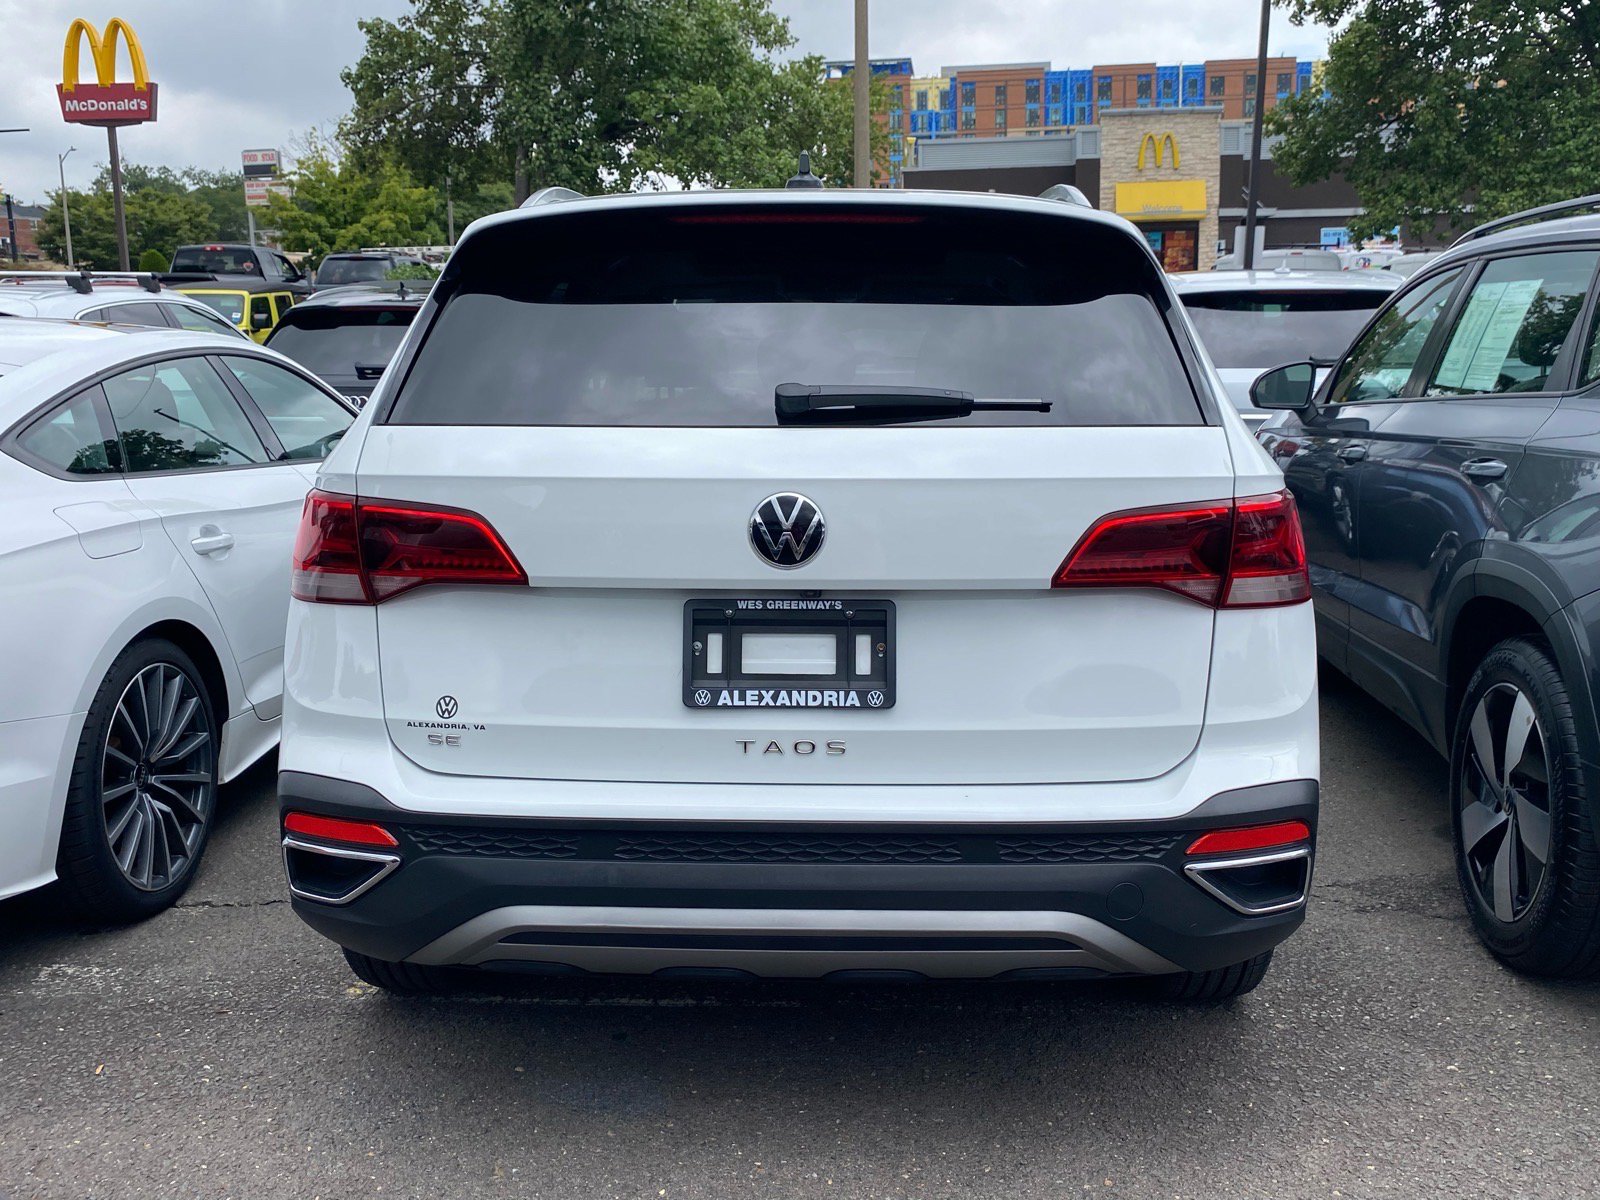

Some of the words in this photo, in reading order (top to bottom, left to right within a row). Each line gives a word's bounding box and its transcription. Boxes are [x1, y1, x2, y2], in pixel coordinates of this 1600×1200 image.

[65, 99, 148, 112] McDonald's
[1143, 203, 1184, 214] Welcome
[737, 600, 763, 609] WES
[767, 600, 843, 610] GREENWAY'S
[717, 690, 861, 707] ALEXANDRIA
[407, 721, 470, 731] ALEXANDRIA,
[427, 733, 462, 747] SE
[735, 739, 847, 755] TAOS
